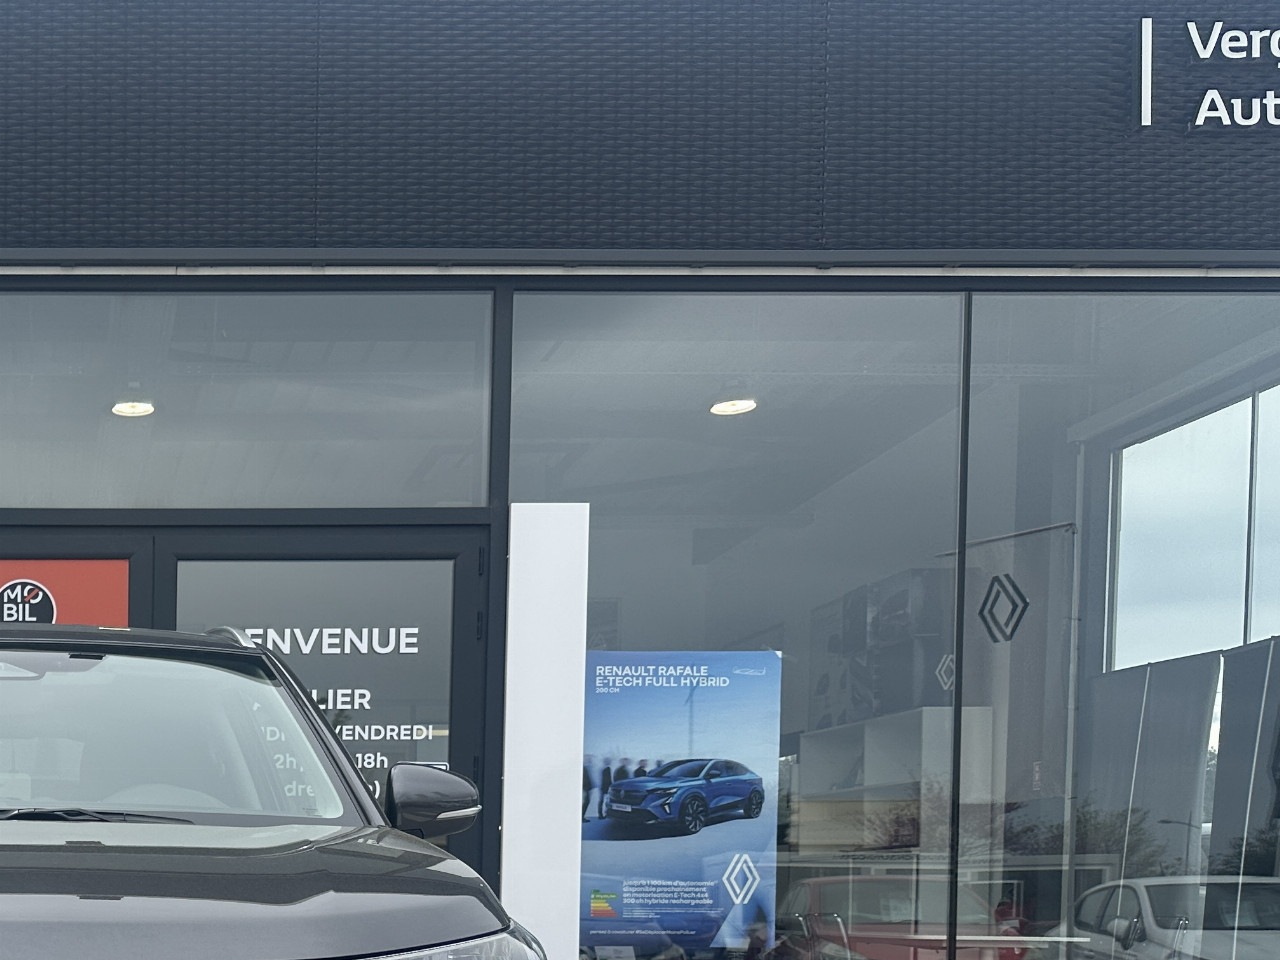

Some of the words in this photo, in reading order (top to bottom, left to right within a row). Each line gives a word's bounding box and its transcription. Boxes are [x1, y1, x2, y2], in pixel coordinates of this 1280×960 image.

[3, 603, 38, 622] BIL
[596, 665, 655, 676] RENAULT
[658, 665, 708, 676] RAFALE
[595, 676, 642, 687] E-TECH
[645, 676, 678, 687] FULL
[680, 676, 730, 687] HYBRID
[308, 689, 371, 710] LIER
